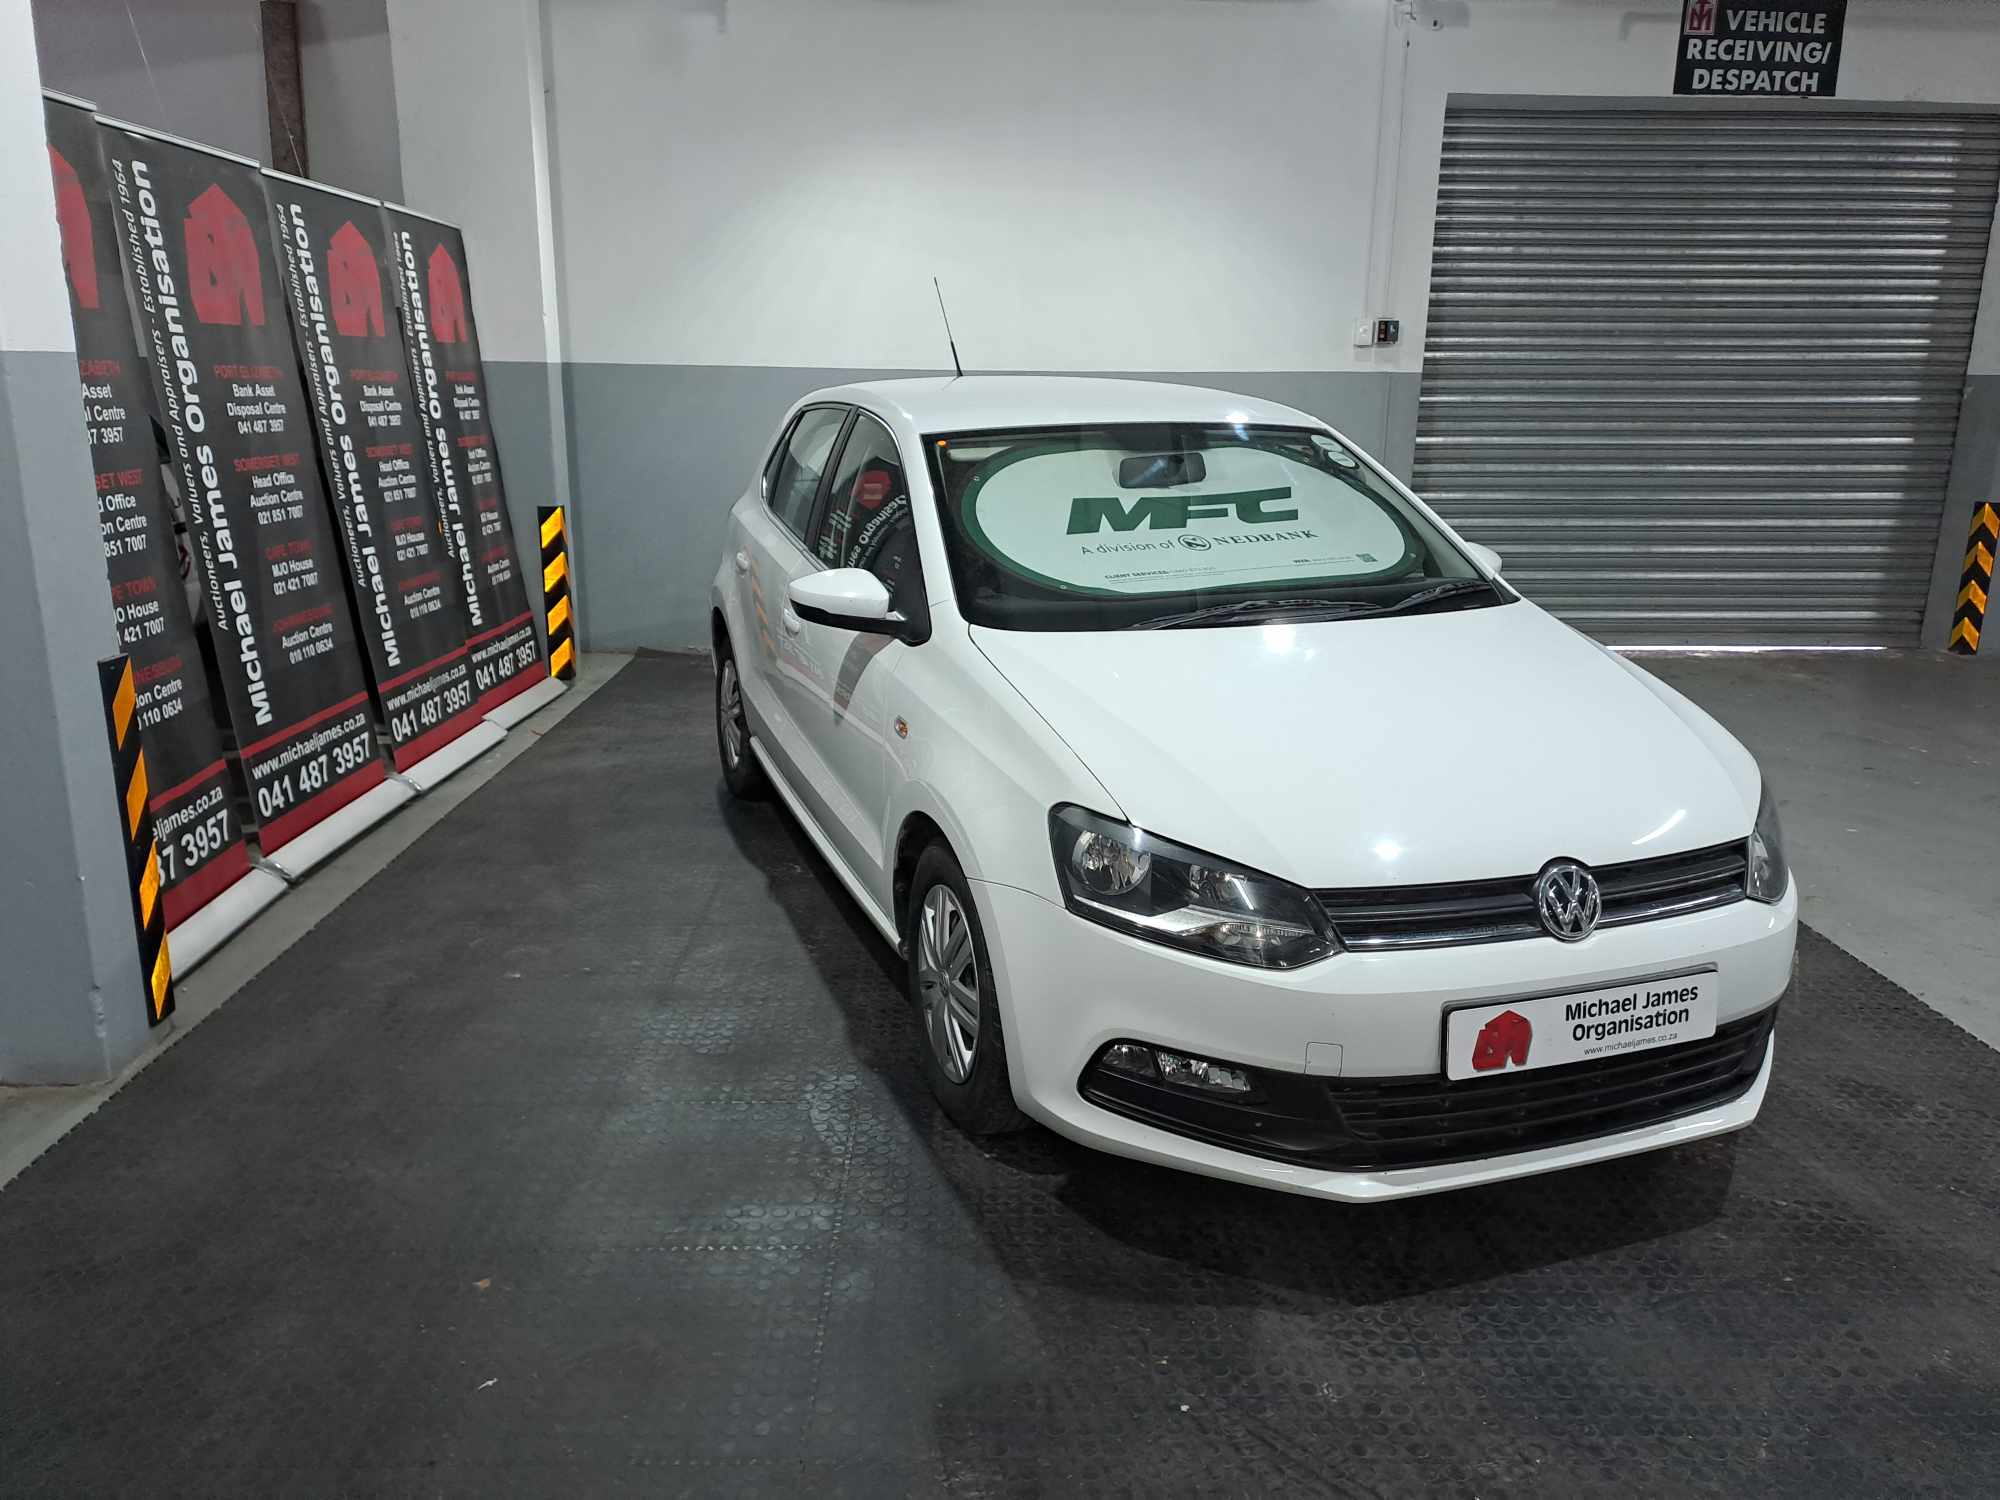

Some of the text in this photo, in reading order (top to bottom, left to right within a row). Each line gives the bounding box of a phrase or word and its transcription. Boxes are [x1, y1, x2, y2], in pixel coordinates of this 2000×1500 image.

[1726, 9, 1827, 34] VEHICLE
[1686, 38, 1832, 65] RECEIVING/
[1692, 68, 1819, 93] DESPATCH
[283, 243, 309, 328] Established
[82, 383, 112, 399] Asset
[232, 383, 276, 398] Bank Asset
[305, 340, 328, 416] Appraisers
[112, 158, 229, 631] Auctioneers, Valuers and Appraisers Established 1964
[93, 405, 126, 422] Centre
[227, 401, 287, 418] Disposal Centre
[101, 426, 123, 444] 3957
[237, 421, 252, 435] 041
[290, 203, 401, 668] Michael James Organisation
[321, 416, 335, 446] and
[401, 231, 482, 627] Michael James Organisation
[131, 160, 273, 727] Michael James Organisation
[252, 471, 296, 489] Head Office
[329, 448, 347, 500] Valuers
[105, 493, 137, 512] Office
[250, 491, 280, 508] Auction
[1066, 486, 1299, 535] MFC
[116, 514, 148, 533] Centre
[257, 510, 272, 526] 021
[125, 534, 147, 552] 7007
[1081, 529, 1319, 555] A division of NEDBANK
[289, 558, 314, 573] House
[273, 581, 287, 596] 021
[287, 576, 301, 592] 421
[127, 600, 159, 621] House
[124, 626, 142, 643] 421
[144, 616, 165, 636] 7007
[282, 622, 333, 649] Auction Centre
[475, 640, 537, 691] 041 487 3957
[153, 677, 183, 700] Centre
[142, 708, 161, 728] 110
[162, 697, 183, 719] 0634
[391, 680, 471, 743] 041 487 3957
[251, 711, 366, 781] www.michaeljames.co.za
[257, 731, 372, 819] 041 487 3957
[181, 808, 230, 867] 3957
[1565, 986, 1699, 1022] Michael James
[1572, 1008, 1690, 1041] Organisation
